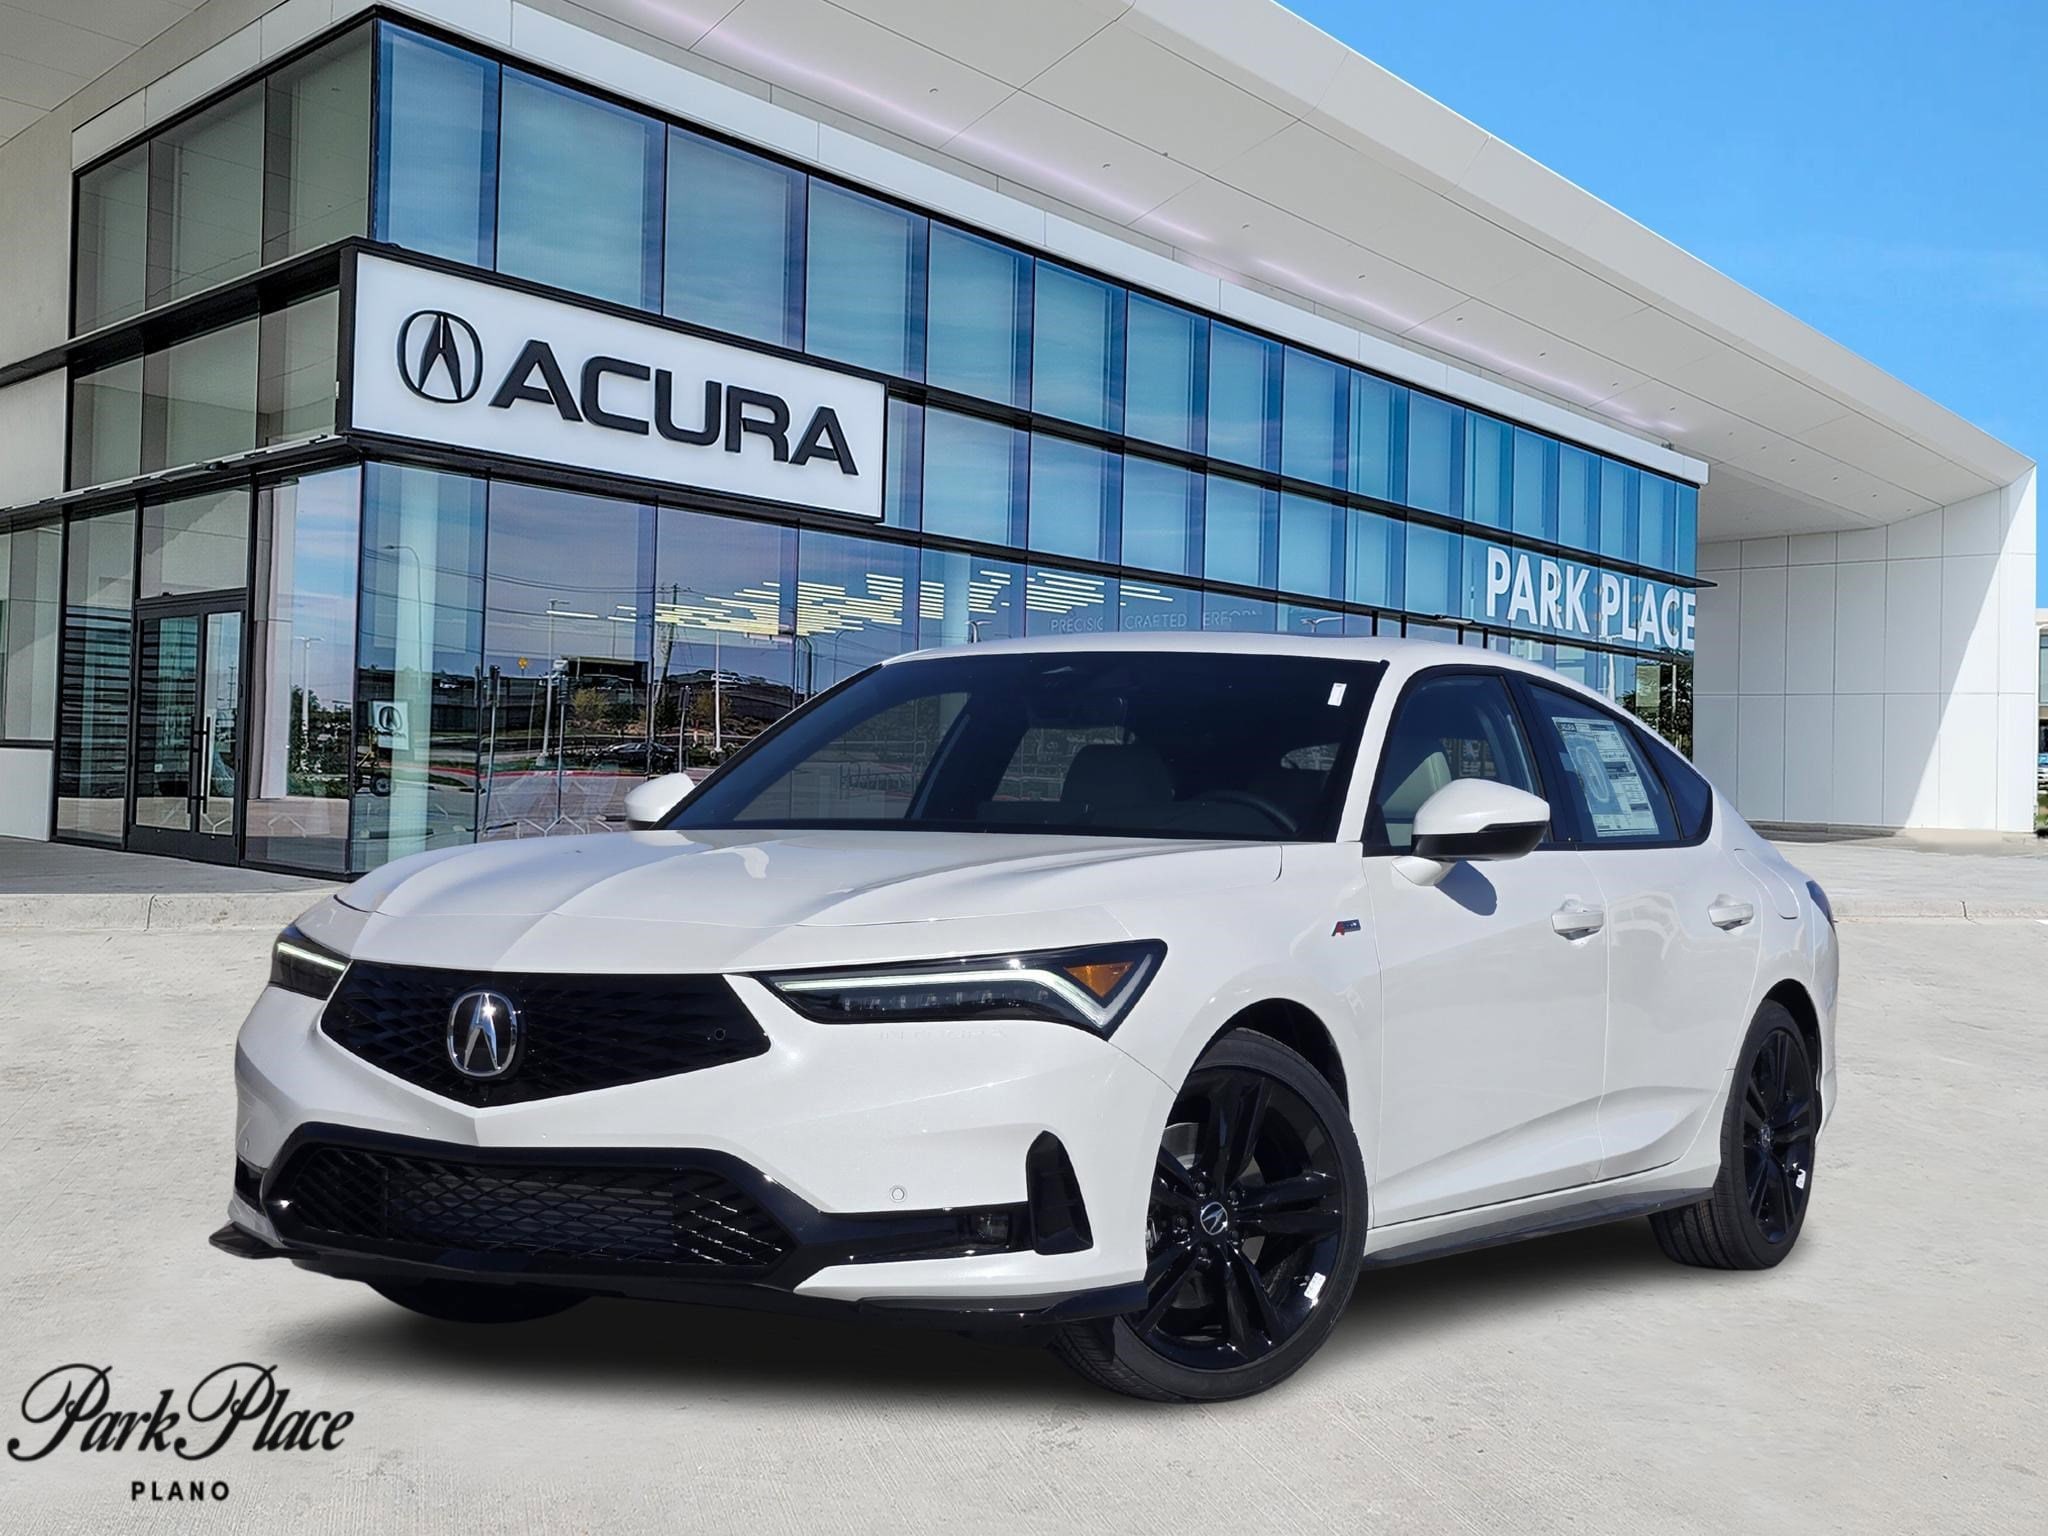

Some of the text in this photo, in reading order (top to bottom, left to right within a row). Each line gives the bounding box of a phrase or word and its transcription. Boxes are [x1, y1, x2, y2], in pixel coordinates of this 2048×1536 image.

[488, 339, 859, 475] ACURA
[1124, 613, 1187, 630] CRAFTED
[1486, 546, 1696, 650] PARK PLACE
